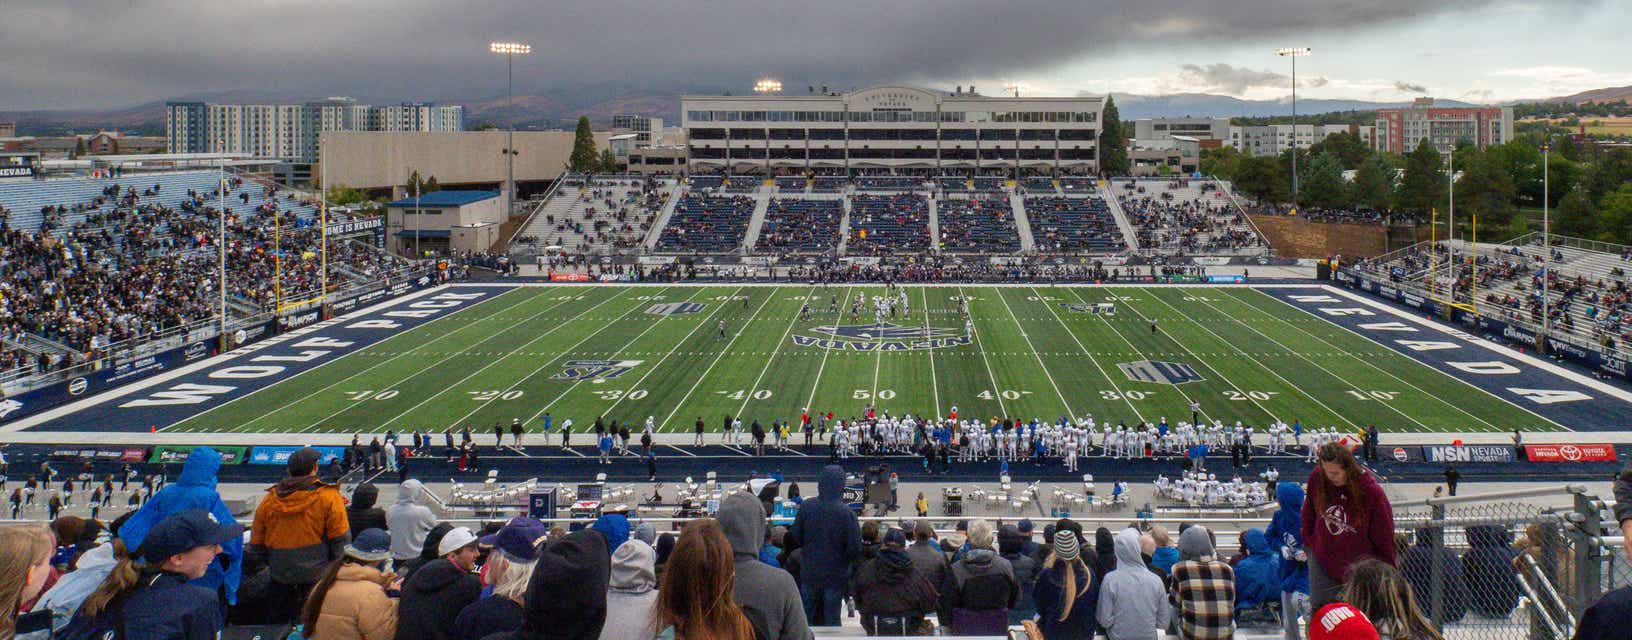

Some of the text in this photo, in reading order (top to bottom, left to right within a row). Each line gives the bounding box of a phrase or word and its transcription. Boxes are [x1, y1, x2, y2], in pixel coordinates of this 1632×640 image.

[345, 223, 353, 232] IS
[354, 219, 382, 231] NEVADA
[791, 334, 971, 352] NEVADA
[118, 291, 488, 408] WOLF PACK
[1287, 295, 1595, 404] NEVADA
[346, 390, 400, 401] 10
[471, 390, 524, 401] 20
[601, 390, 649, 400] 30
[726, 389, 773, 400] 40
[852, 389, 897, 400] 50
[976, 390, 1020, 400] 40
[1098, 390, 1146, 401] 30
[1222, 390, 1270, 401] 20
[1345, 390, 1394, 401] 10
[1432, 446, 1470, 462] NSN
[1471, 447, 1510, 456] NEVADA
